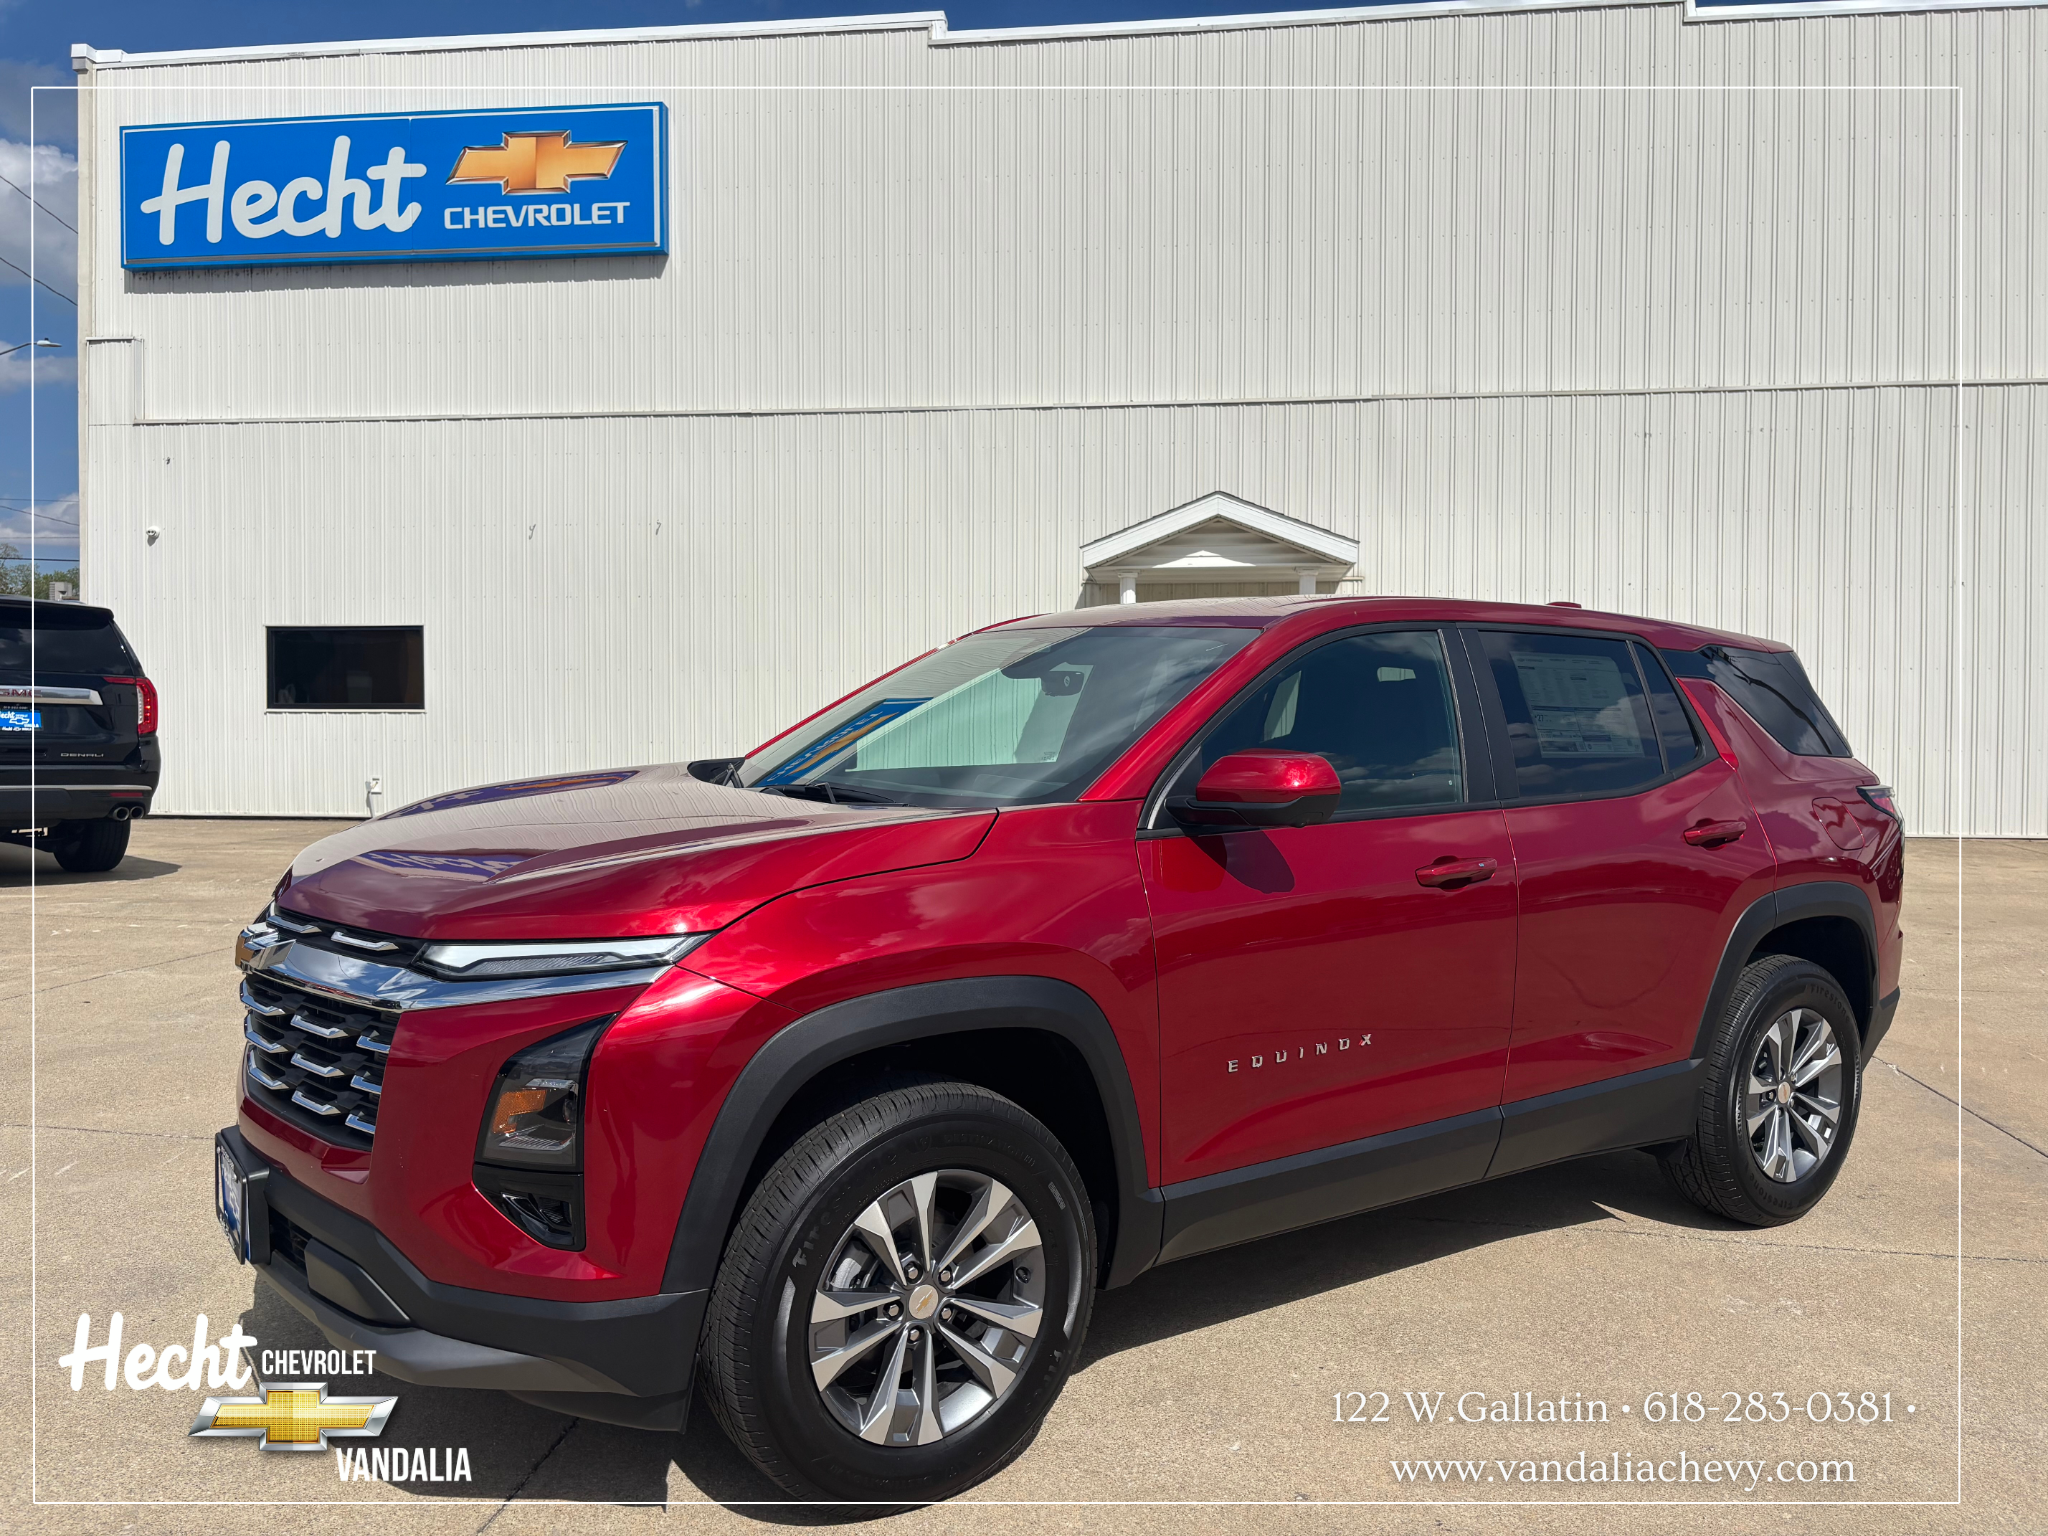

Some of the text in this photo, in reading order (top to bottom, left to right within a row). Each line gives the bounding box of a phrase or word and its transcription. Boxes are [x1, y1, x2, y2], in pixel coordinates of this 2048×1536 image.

[140, 135, 427, 245] Hecht
[444, 201, 630, 230] CHEVROLET
[0, 688, 42, 698] GMC
[1810, 983, 1850, 1024] Firestone
[1228, 1034, 1372, 1073] EQUINOX
